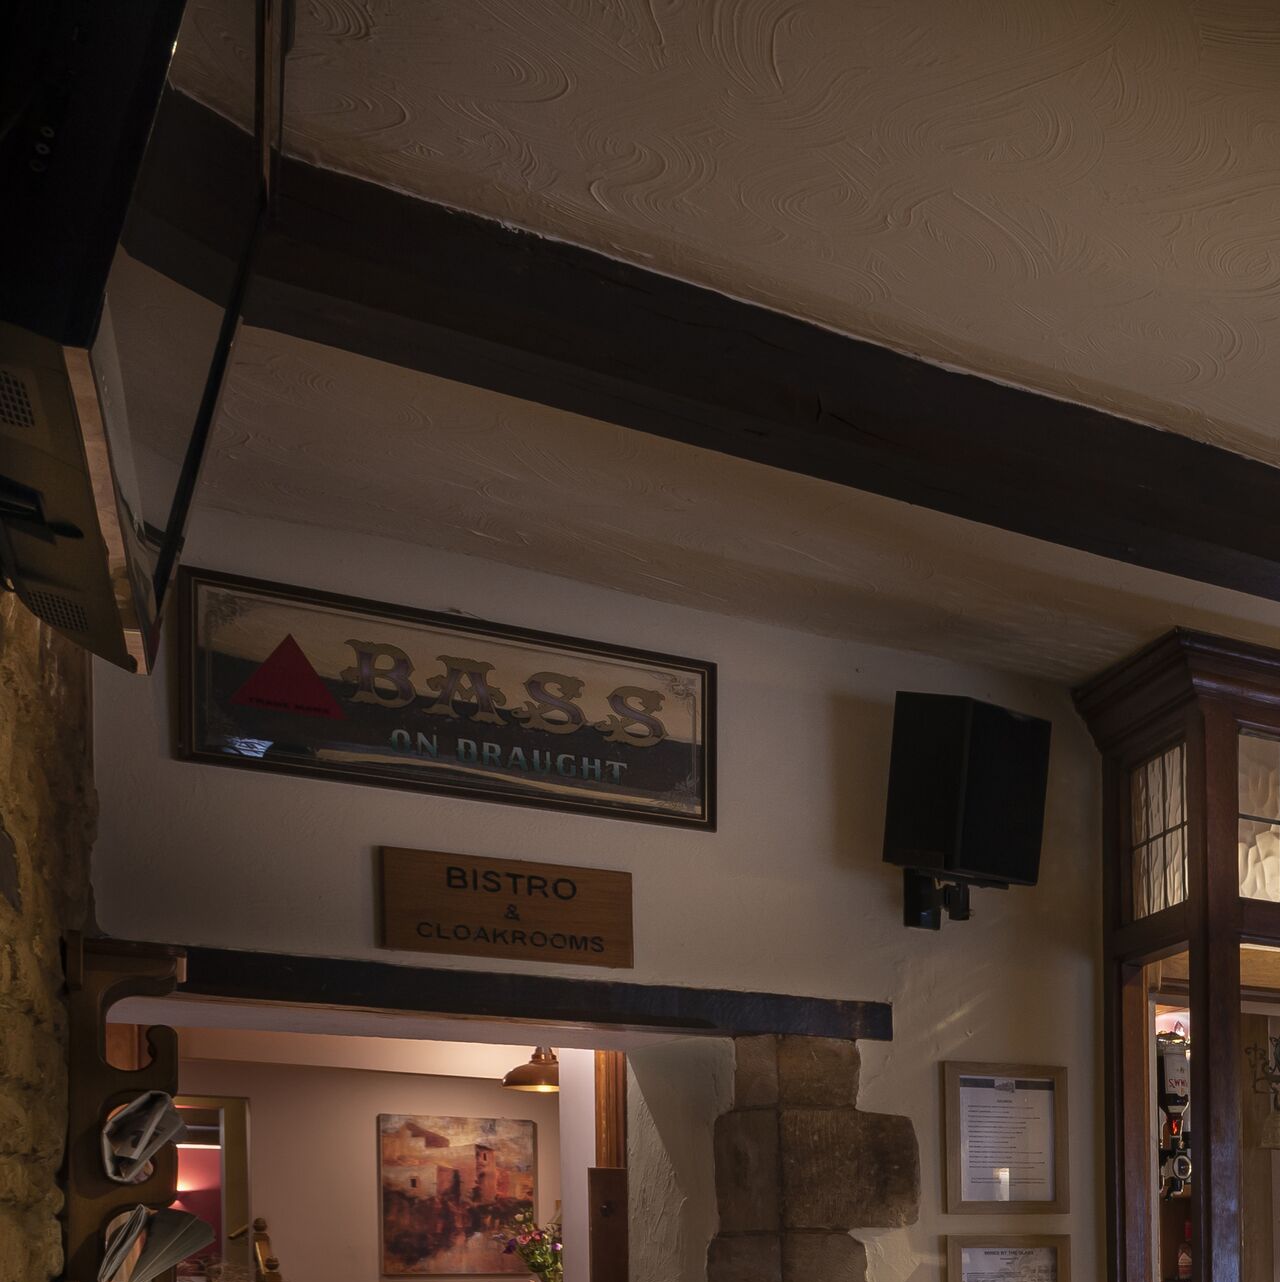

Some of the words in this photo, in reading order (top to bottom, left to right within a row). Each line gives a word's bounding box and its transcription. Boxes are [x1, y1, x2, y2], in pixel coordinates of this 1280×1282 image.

[340, 638, 669, 747] BASS
[388, 728, 439, 759] ON
[456, 736, 628, 785] DRAUGHT
[445, 866, 577, 901] BISTRO
[504, 903, 521, 920] &
[416, 921, 605, 953] CLOAKROOMS
